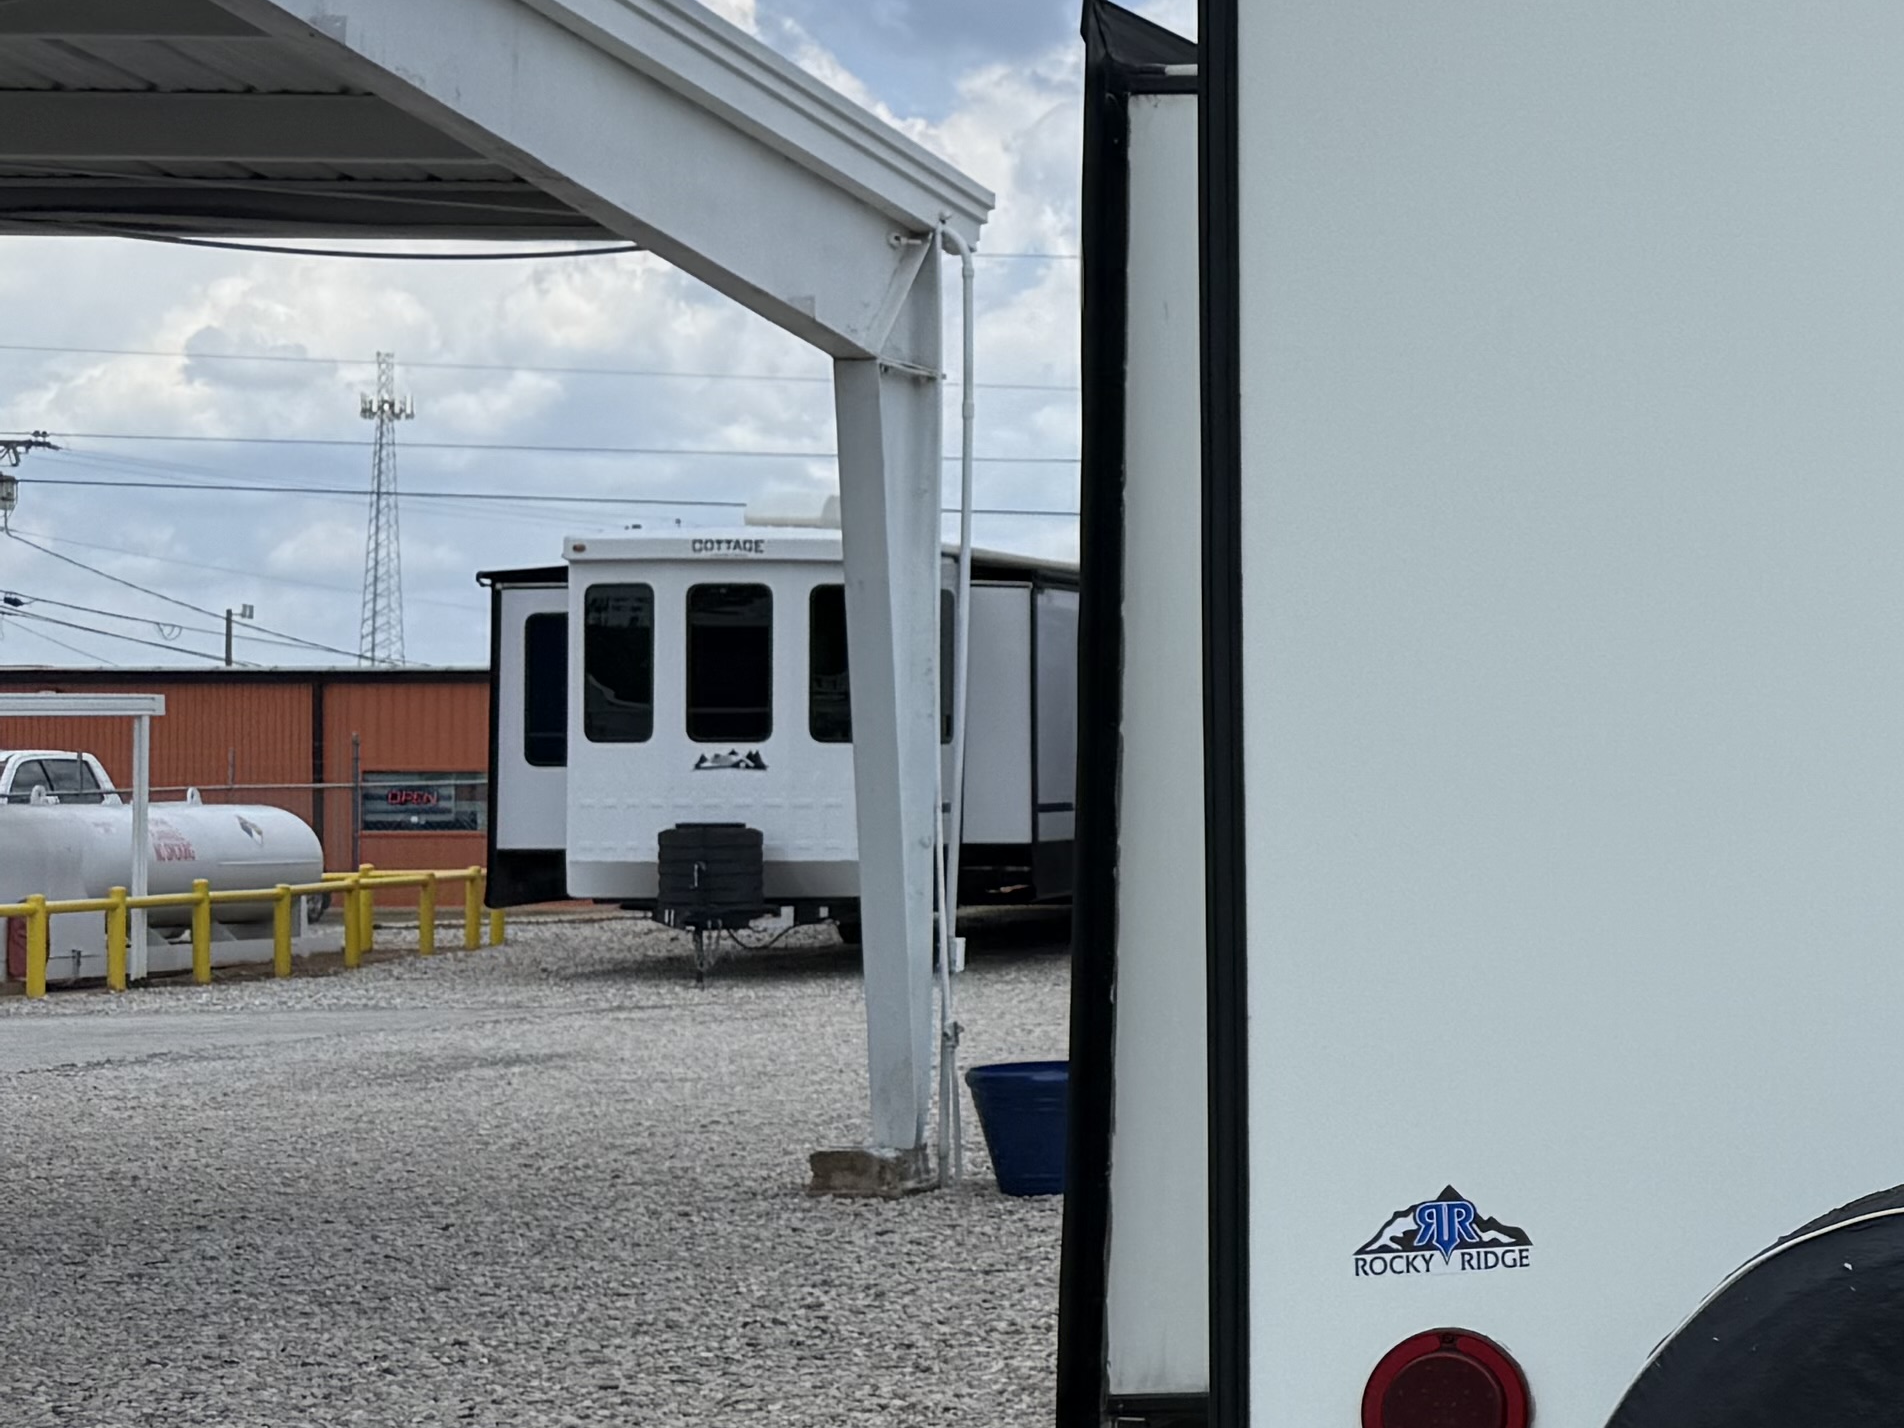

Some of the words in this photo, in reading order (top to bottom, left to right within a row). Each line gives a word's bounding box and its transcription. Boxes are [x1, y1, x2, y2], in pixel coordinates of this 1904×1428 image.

[691, 538, 766, 554] COTTAGE
[387, 789, 438, 806] OPEN
[1354, 1253, 1434, 1277] ROCKY
[1460, 1248, 1531, 1272] RIDGE
